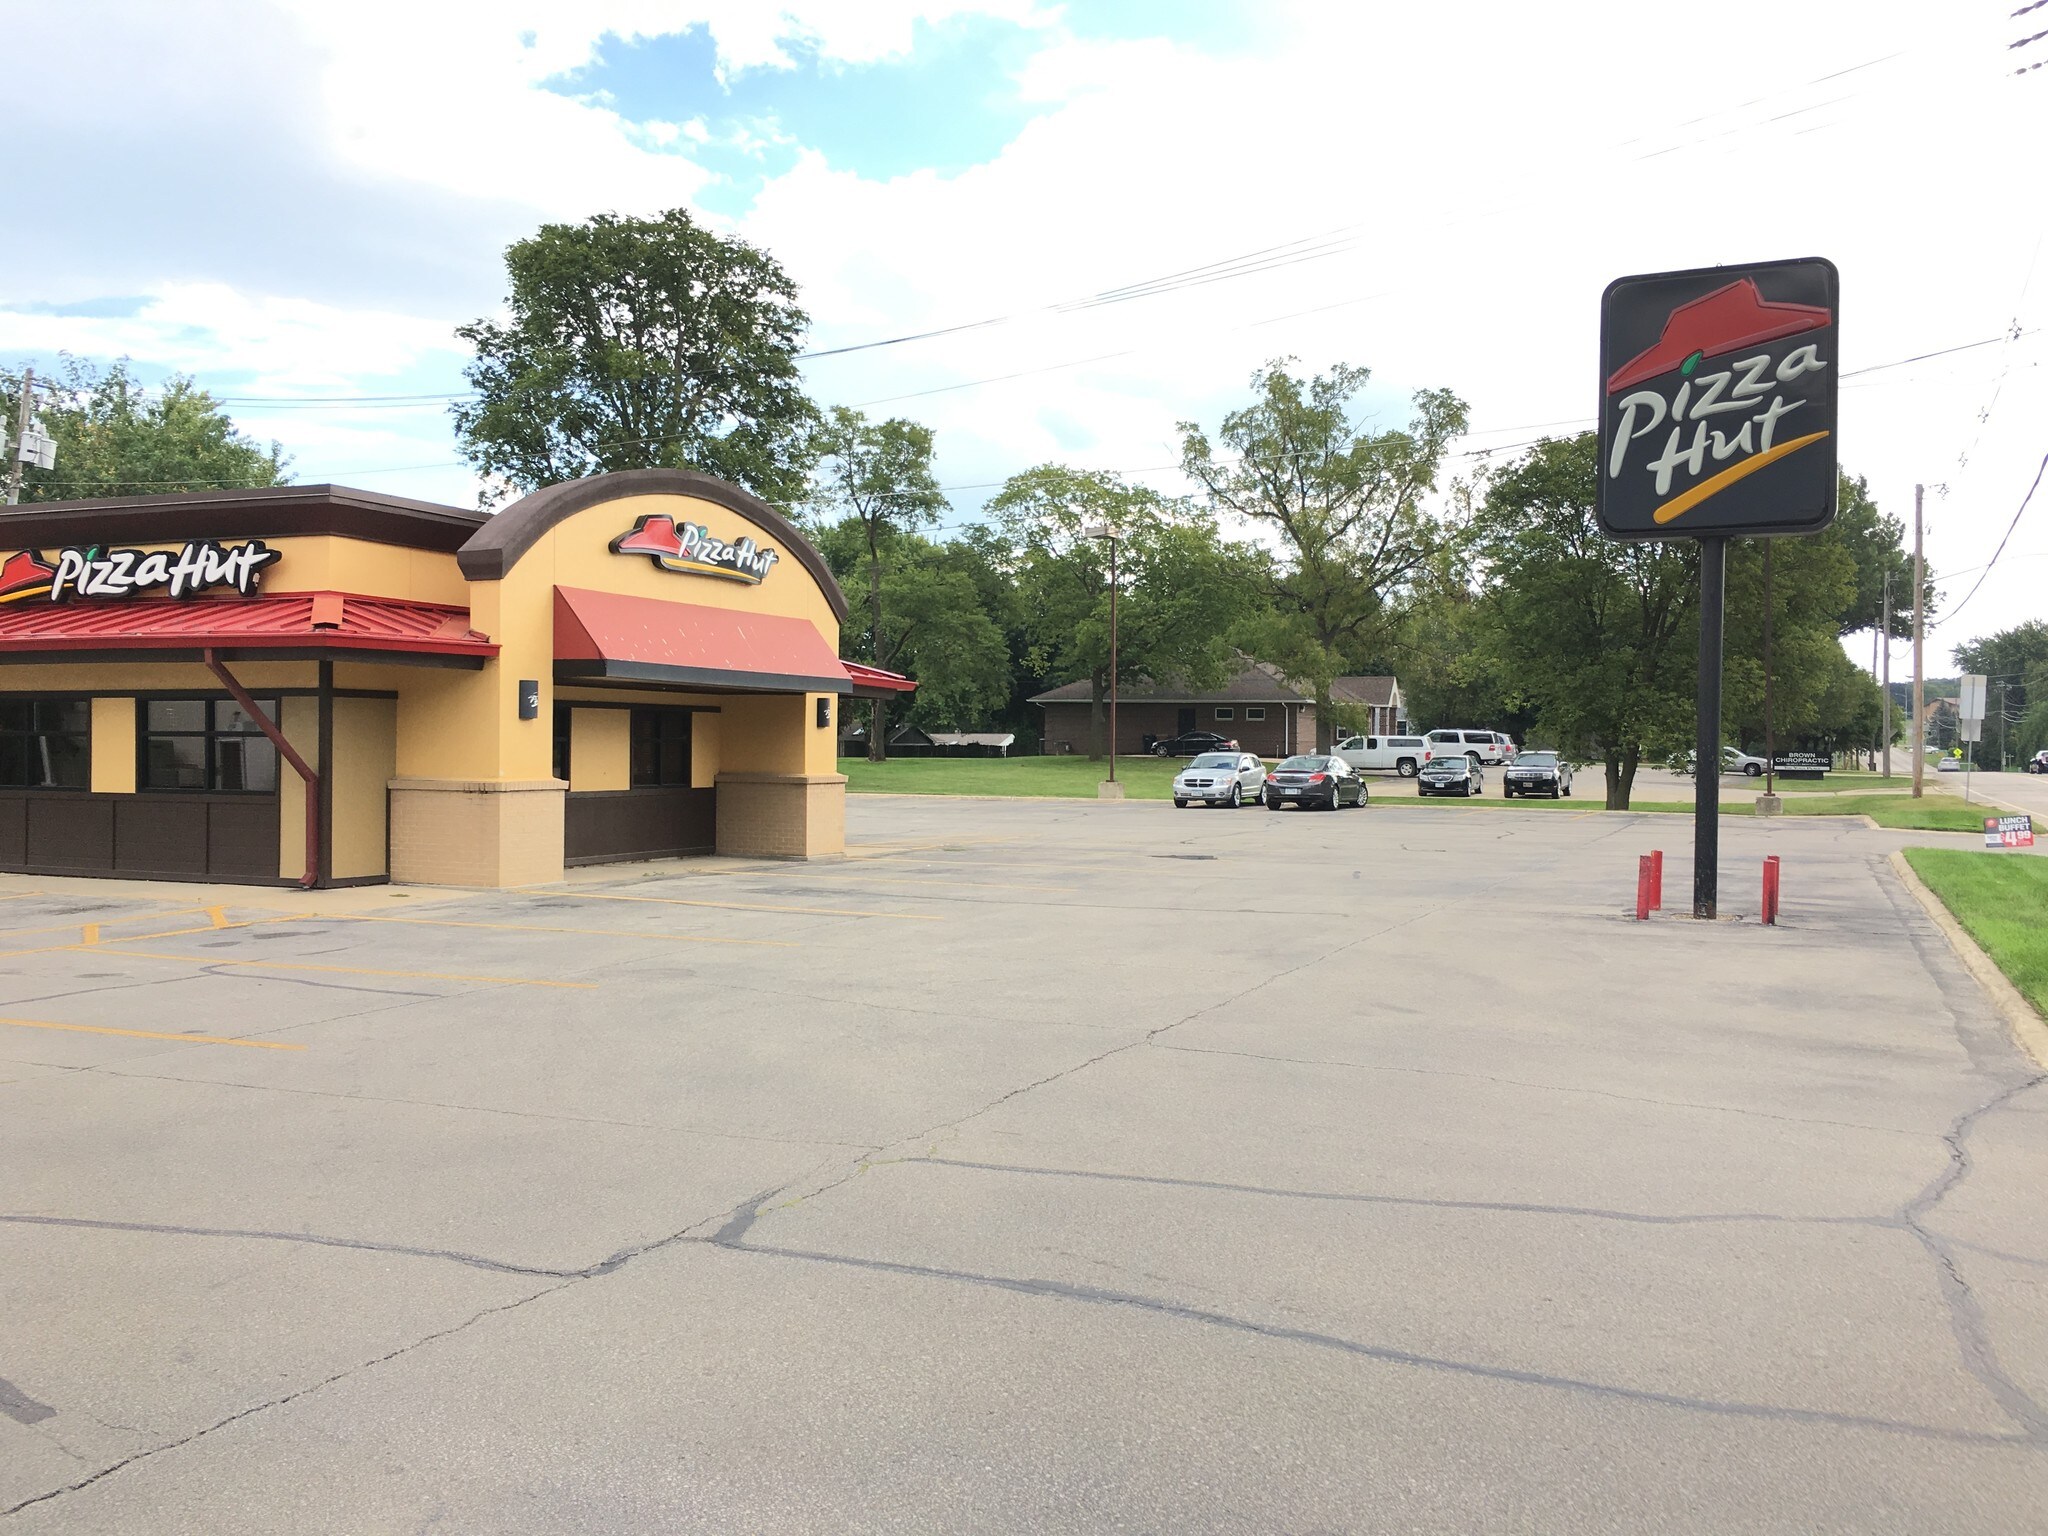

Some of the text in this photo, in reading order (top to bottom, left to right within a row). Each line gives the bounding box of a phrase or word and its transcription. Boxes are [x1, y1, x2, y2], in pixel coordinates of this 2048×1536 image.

[1610, 344, 1827, 479] Pizza
[1646, 395, 1807, 496] Hut
[1999, 823, 2030, 831] BUFFET
